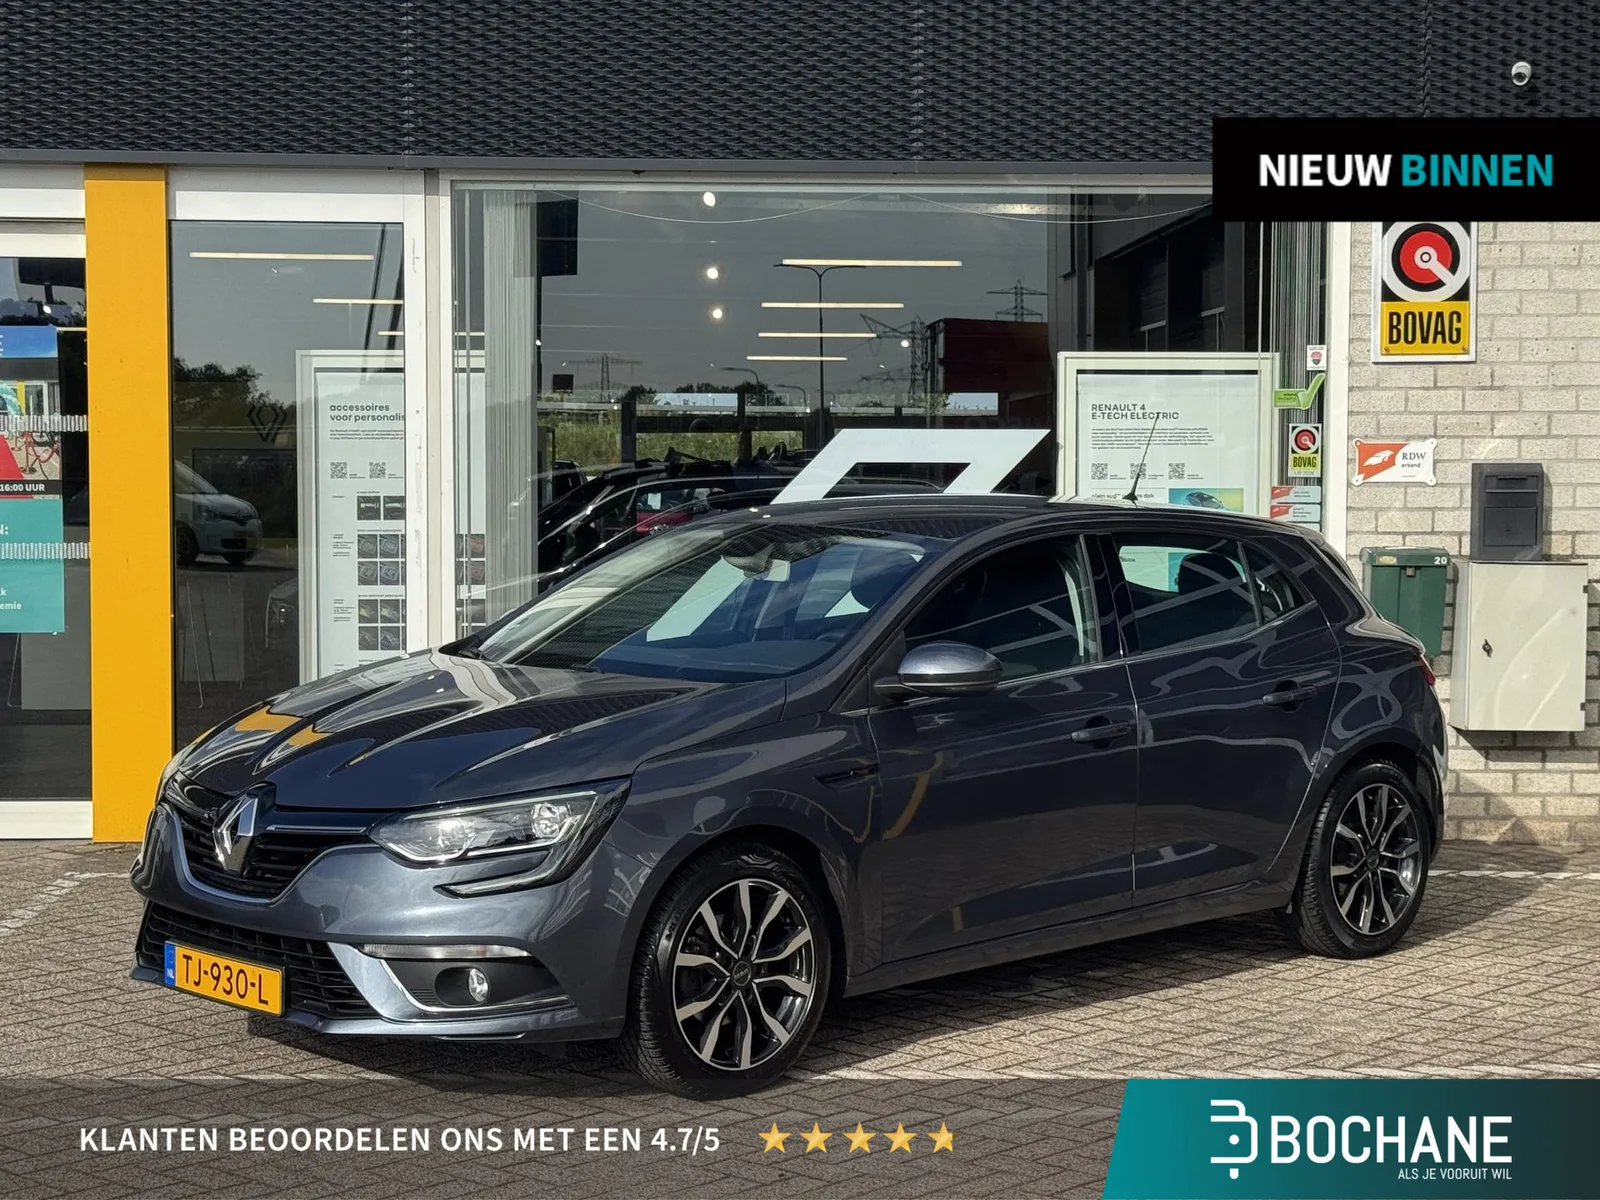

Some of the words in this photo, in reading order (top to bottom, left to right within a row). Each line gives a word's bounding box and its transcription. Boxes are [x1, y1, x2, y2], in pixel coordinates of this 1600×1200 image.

[1388, 310, 1462, 345] BOVAG
[329, 403, 390, 412] accessoires
[1091, 403, 1138, 411] RENAULT
[1139, 403, 1146, 411] 4
[1091, 412, 1128, 420] E-TECH
[1130, 412, 1179, 420] ELECTRIC
[1401, 452, 1427, 461] RDW
[1292, 456, 1317, 468] BOVAG
[25, 483, 45, 492] UUR
[1434, 556, 1448, 565] 20
[166, 967, 175, 979] NL
[182, 953, 269, 1006] TJ-930-L
